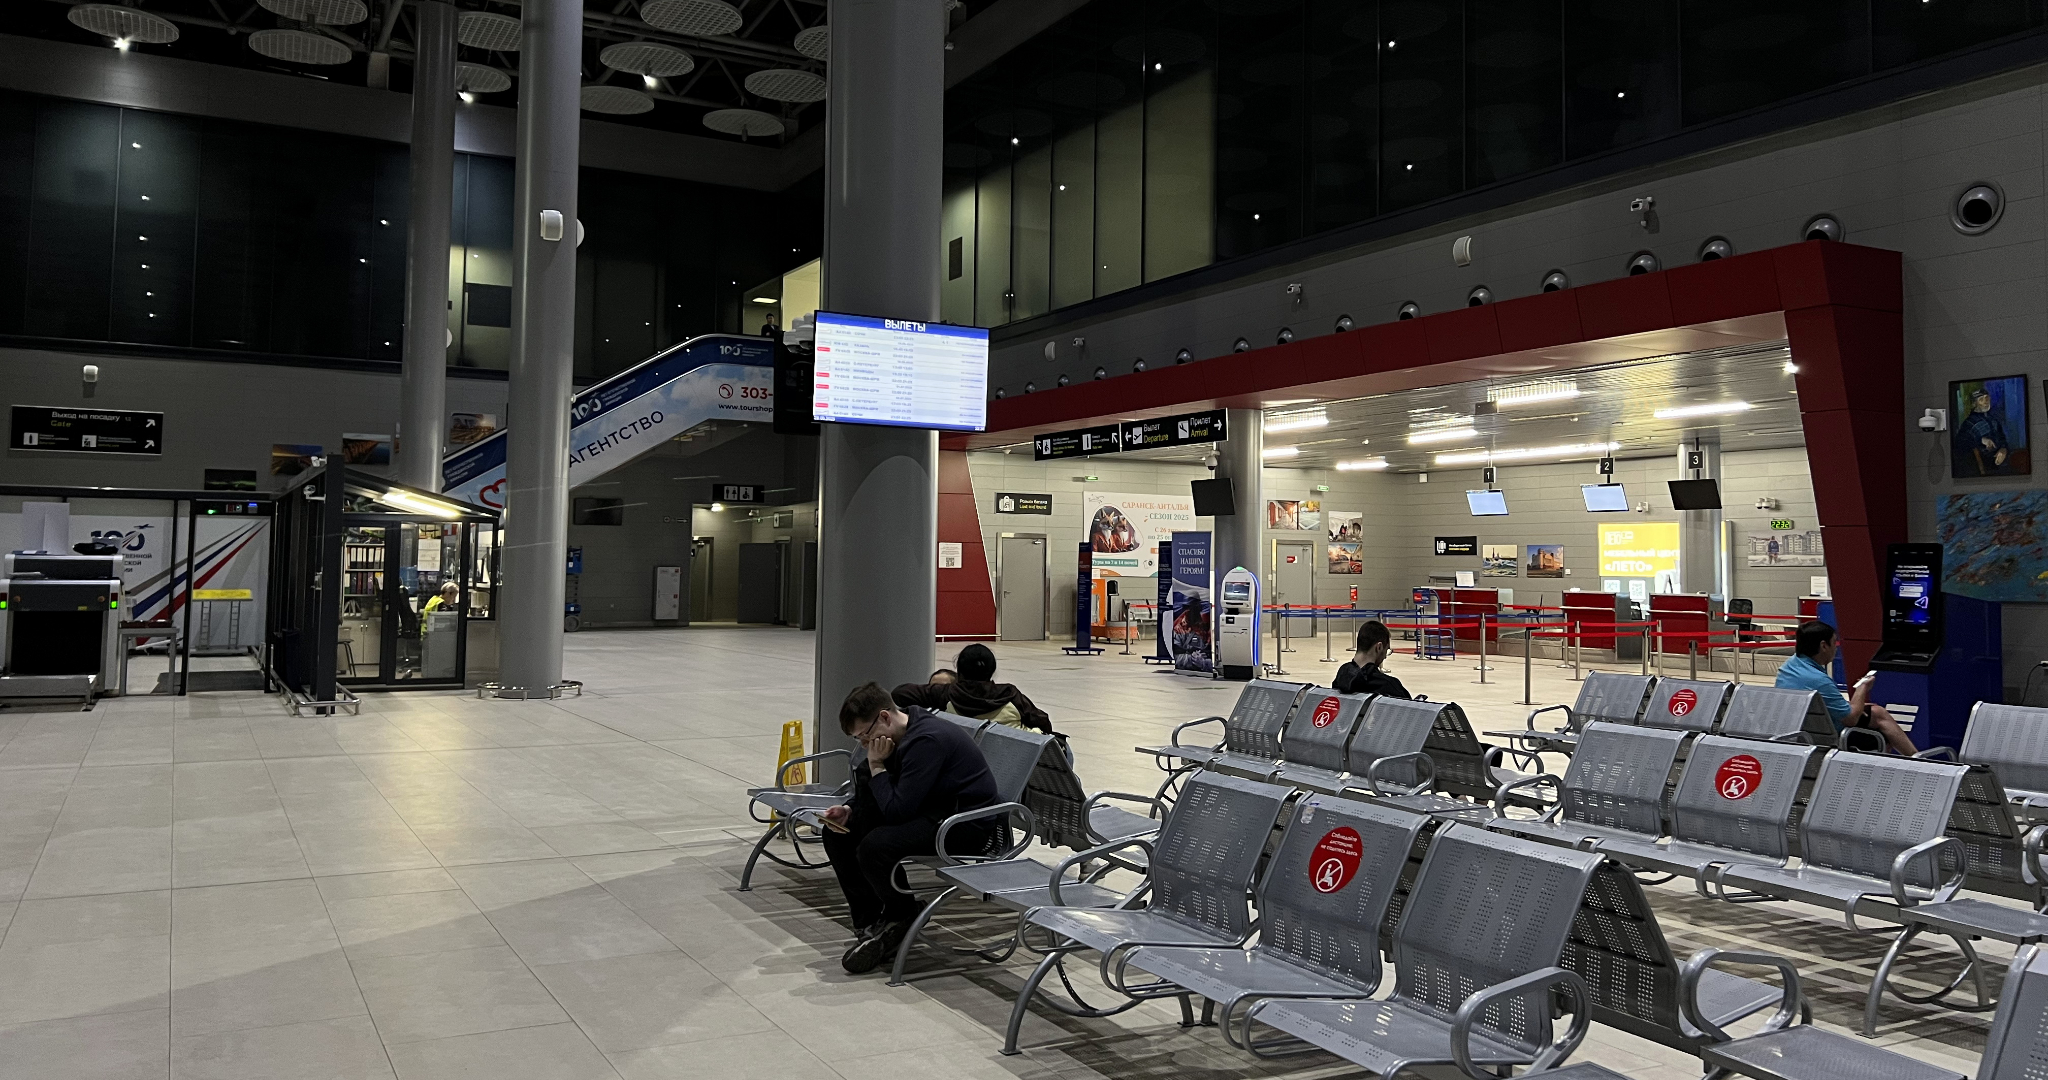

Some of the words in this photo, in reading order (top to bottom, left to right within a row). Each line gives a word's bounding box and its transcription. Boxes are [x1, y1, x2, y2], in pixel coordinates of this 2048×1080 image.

[885, 319, 926, 332] ВЫЛЕТЫ
[51, 411, 77, 419] Выход
[90, 414, 120, 422] посадку
[1190, 417, 1211, 427] Прилет
[1143, 423, 1160, 432] Вылет
[1190, 428, 1209, 437] Arrival
[569, 411, 664, 468] АГЕНТСТВО
[1143, 434, 1169, 444] Departure
[1693, 456, 1699, 464] 3
[1605, 462, 1610, 471] 2
[1486, 471, 1490, 480] 1
[1121, 501, 1189, 511] САРАНСК-АНТАЛЬЯ
[1178, 548, 1206, 556] СПАСИБО
[1180, 557, 1204, 565] НАШИМ
[1180, 566, 1205, 575] ГЕРОЯМ!
[1605, 561, 1653, 572] «ЛЕТО»
